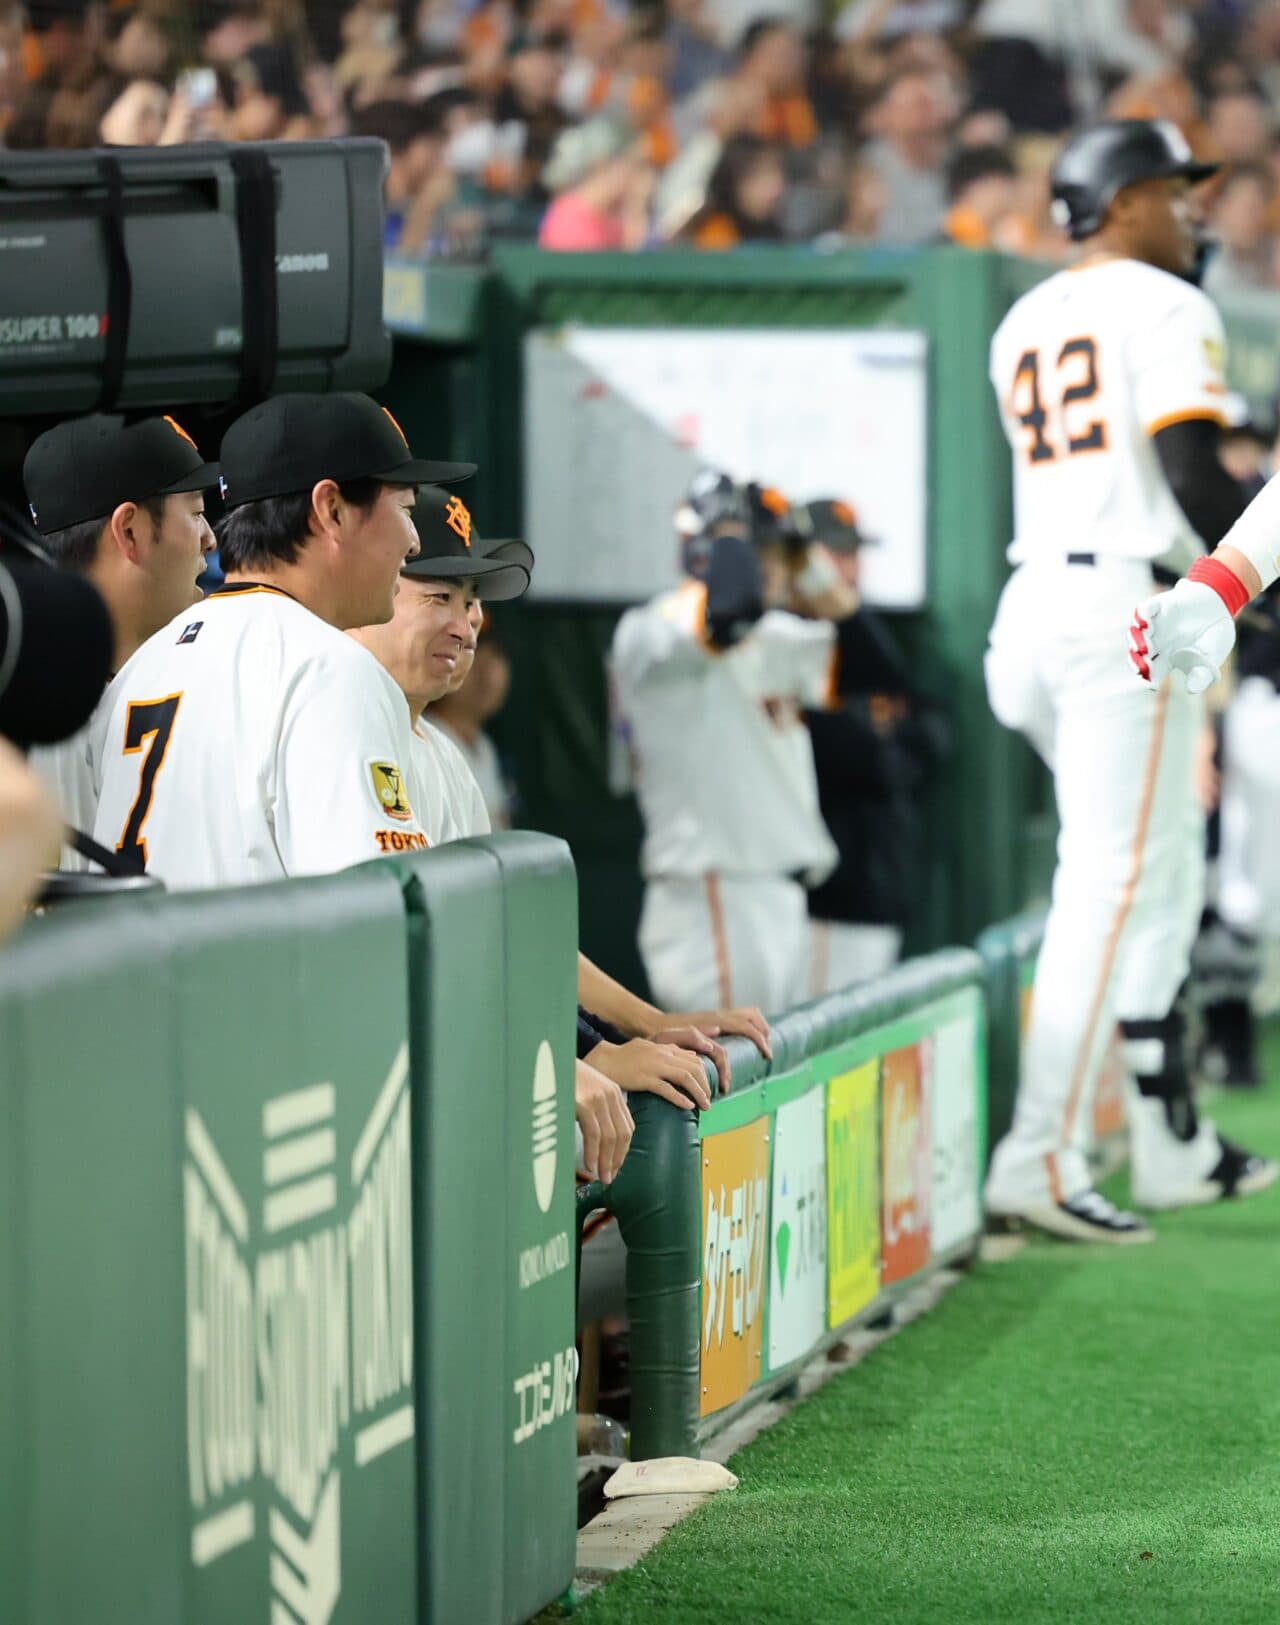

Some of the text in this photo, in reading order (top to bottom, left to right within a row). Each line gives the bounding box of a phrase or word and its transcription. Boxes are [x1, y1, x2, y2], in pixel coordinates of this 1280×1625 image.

[64, 313, 99, 339] 100
[1010, 336, 1107, 466] 42
[117, 690, 184, 865] 7
